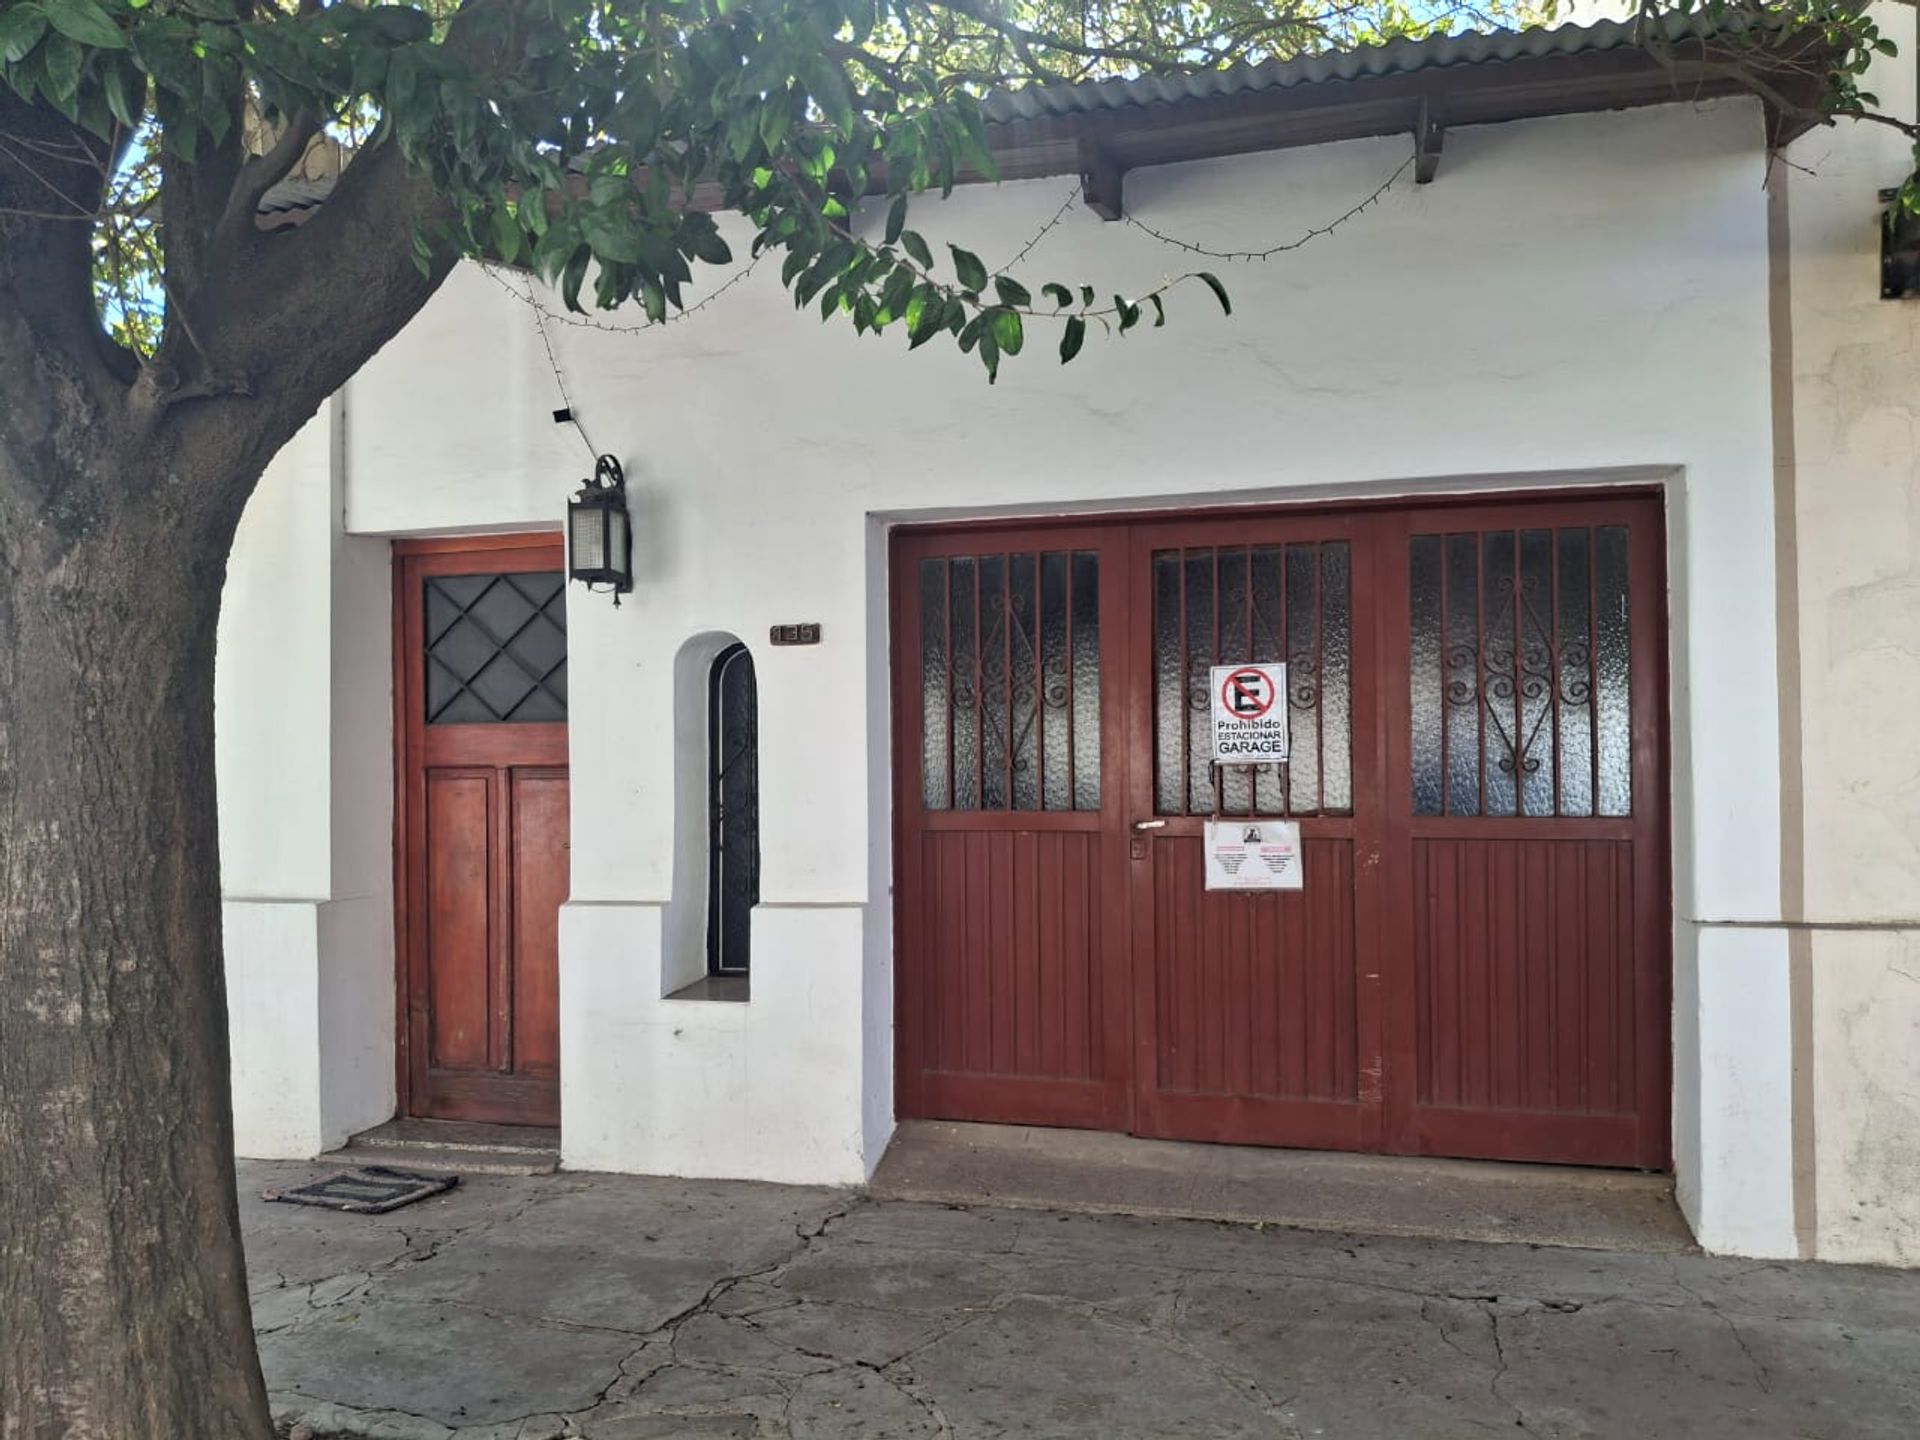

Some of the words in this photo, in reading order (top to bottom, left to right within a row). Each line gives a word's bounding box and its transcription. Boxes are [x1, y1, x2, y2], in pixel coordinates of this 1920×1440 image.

[1218, 719, 1281, 730] Prohibido
[1218, 731, 1281, 740] ESTACIONAR
[1219, 741, 1282, 754] GARAGE
